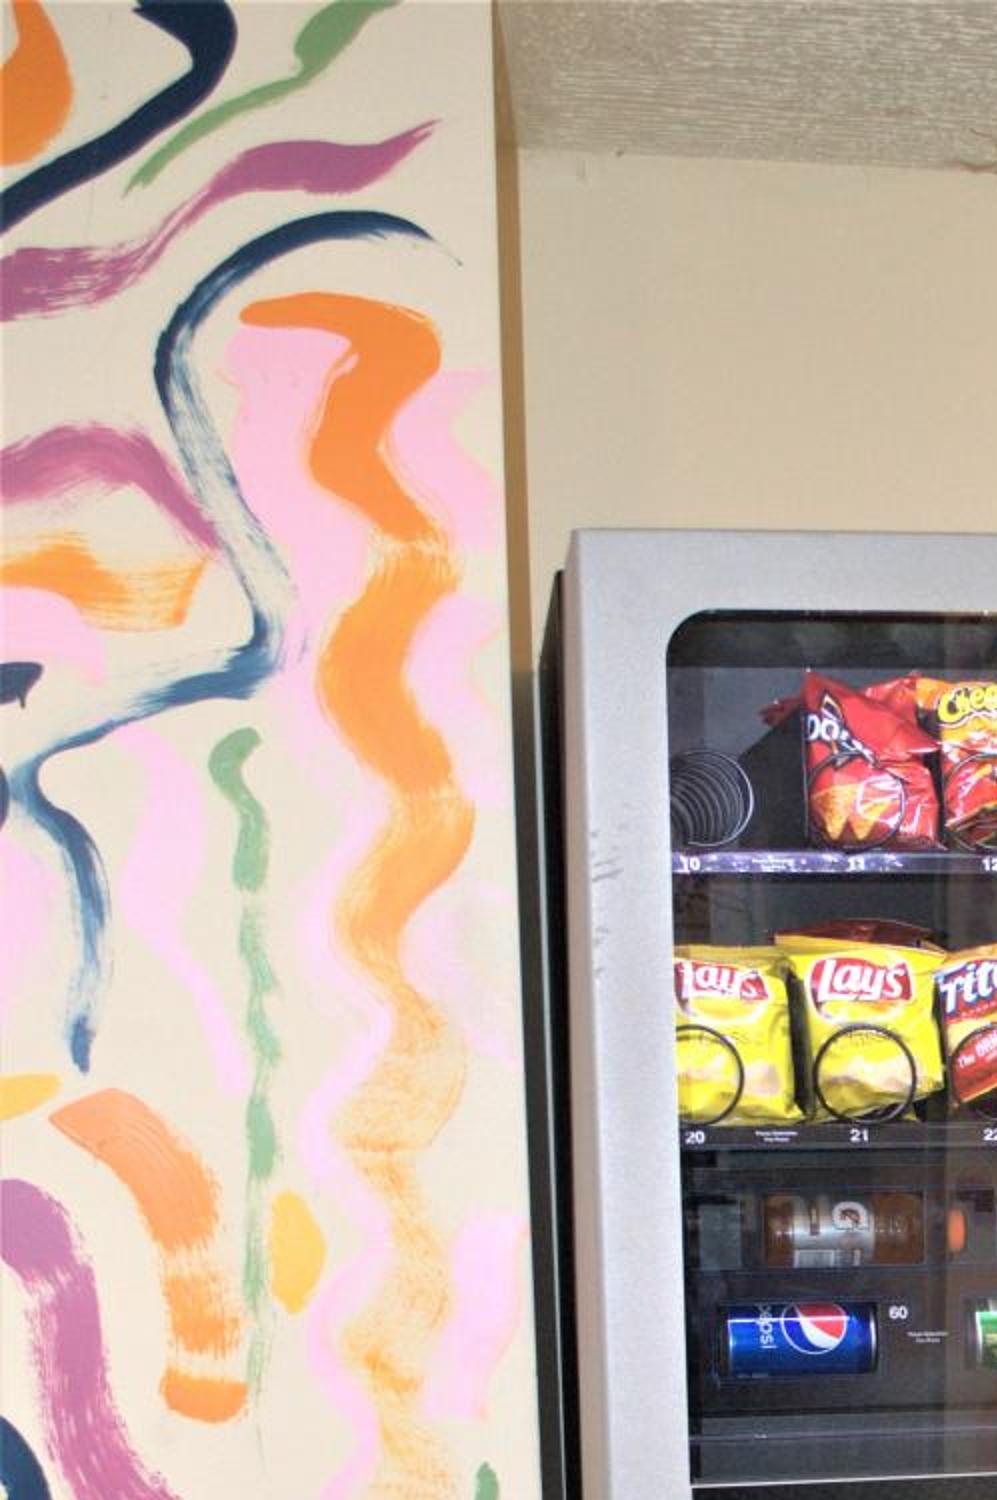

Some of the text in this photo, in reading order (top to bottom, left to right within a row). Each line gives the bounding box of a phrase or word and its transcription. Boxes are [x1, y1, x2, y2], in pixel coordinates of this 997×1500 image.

[682, 857, 700, 872] 10
[685, 1130, 704, 1145] 20
[850, 1130, 868, 1143] 21
[889, 1306, 907, 1320] 60
